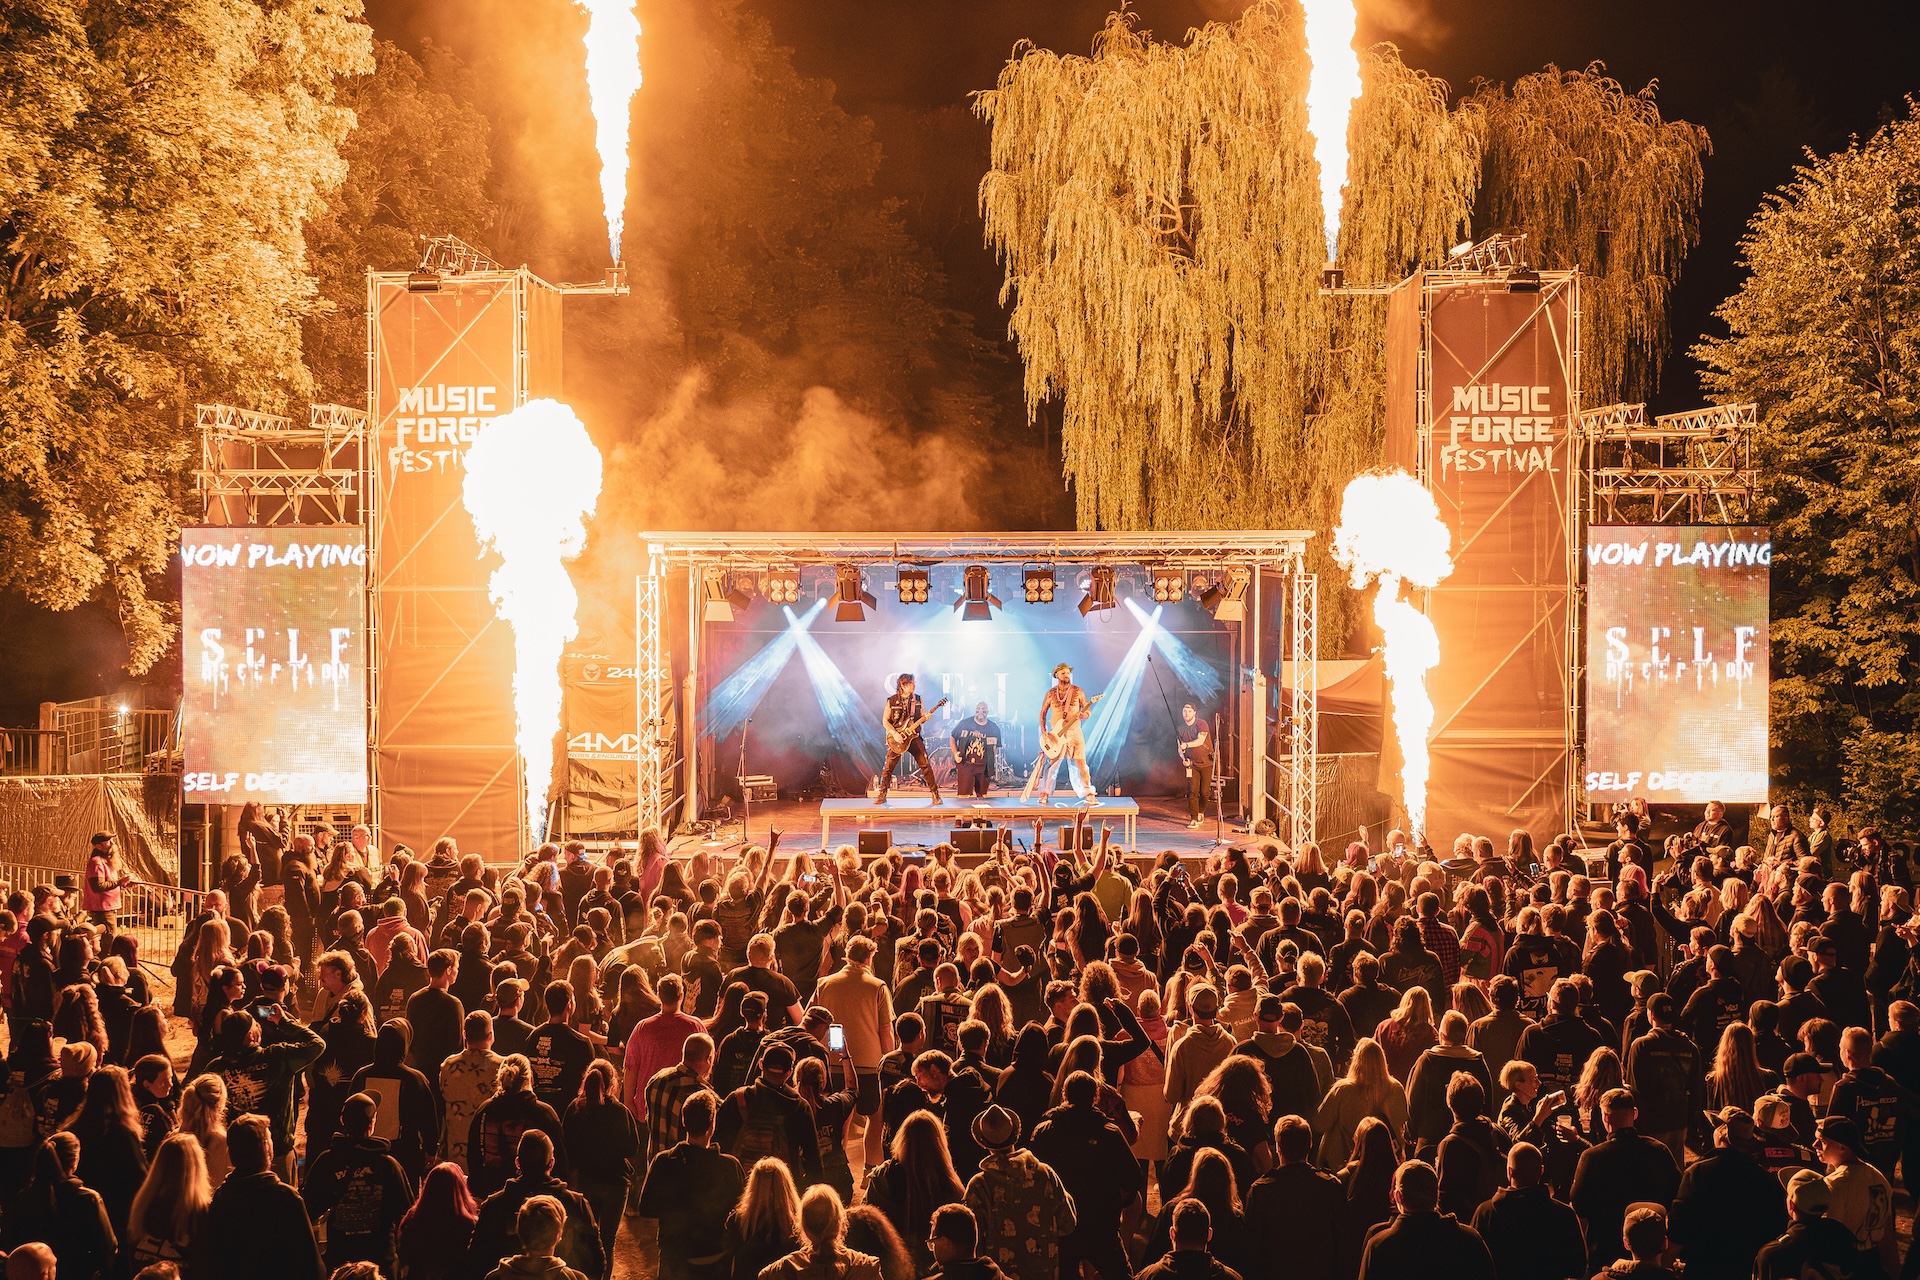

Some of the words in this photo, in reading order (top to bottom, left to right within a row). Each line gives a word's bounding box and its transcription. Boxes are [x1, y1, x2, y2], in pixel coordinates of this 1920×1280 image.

[398, 383, 496, 415] MUSIC
[1452, 383, 1550, 414] MUSIC
[1449, 416, 1554, 446] FORGE
[387, 444, 466, 483] FESTI
[1439, 443, 1560, 483] FESTIVAL
[248, 543, 366, 569] PLAYING
[1655, 541, 1770, 568] PLAYING
[200, 628, 350, 674] SELF
[1605, 625, 1755, 673] SELF
[567, 732, 650, 753] 4MX
[184, 772, 239, 793] SELF
[1586, 771, 1642, 792] SELF
